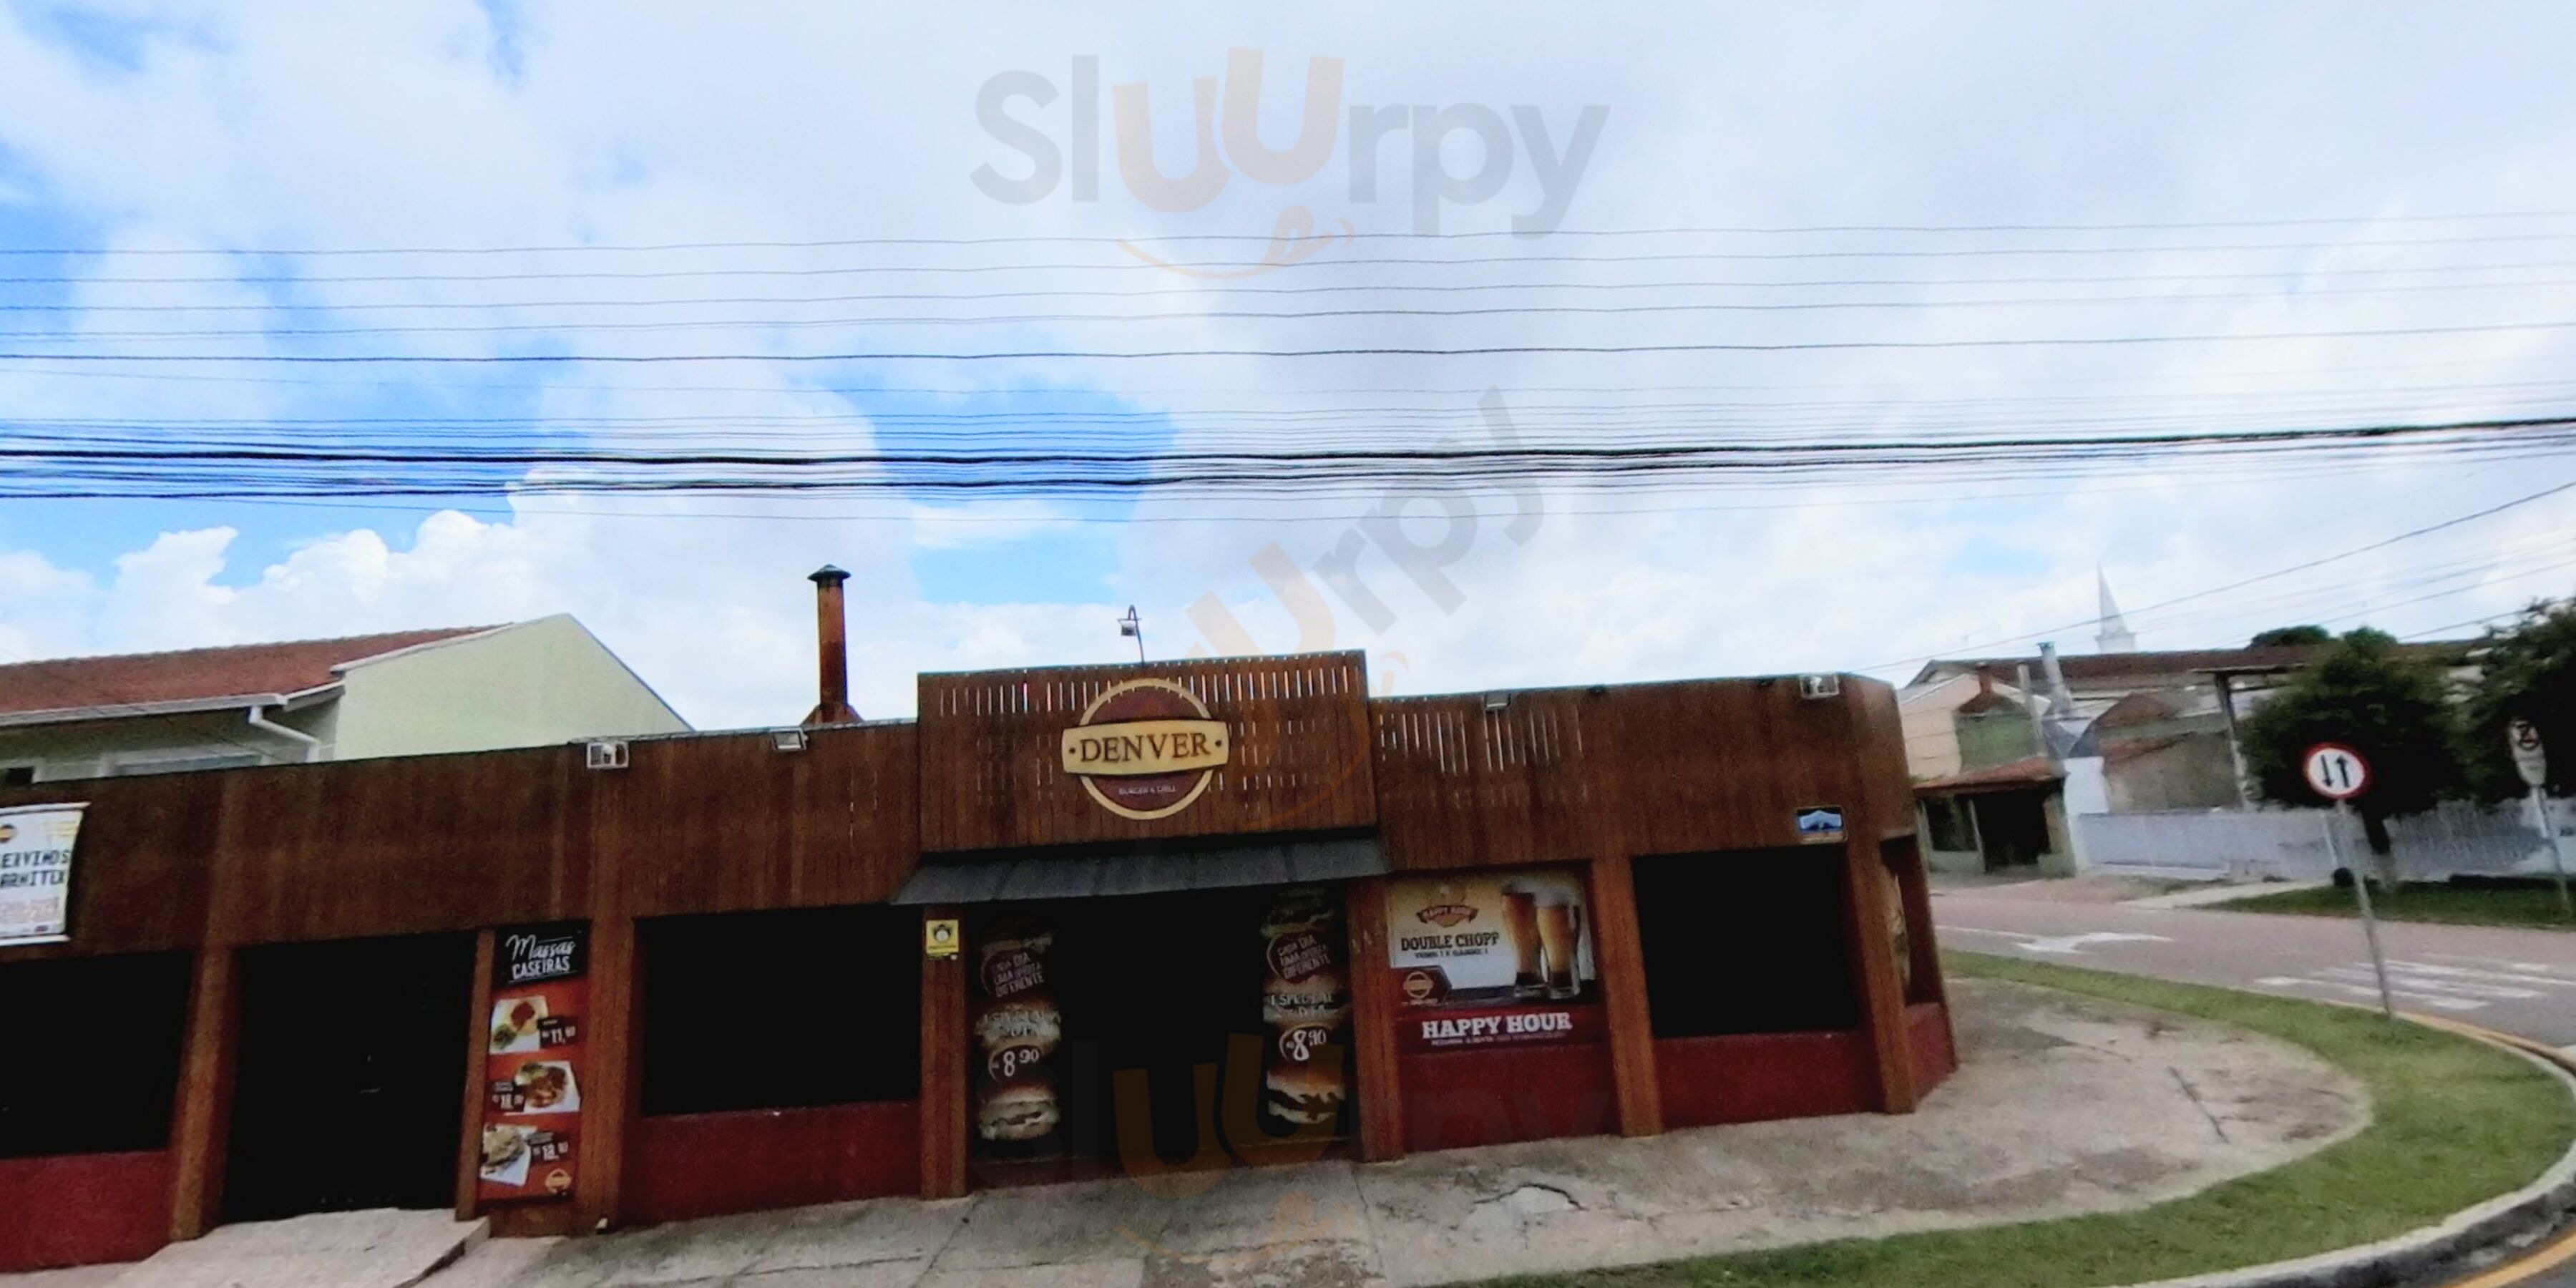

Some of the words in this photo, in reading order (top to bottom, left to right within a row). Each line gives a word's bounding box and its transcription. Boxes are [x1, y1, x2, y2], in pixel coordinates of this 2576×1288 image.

[1080, 732, 1211, 763] DENVER
[506, 935, 575, 961] Massas
[1401, 935, 1453, 951] DOUBLE
[1455, 932, 1500, 948] CHOPP
[512, 956, 570, 980] CASEIRAS
[1422, 1015, 1502, 1038] HAPPY
[1506, 1012, 1573, 1033] HOUR
